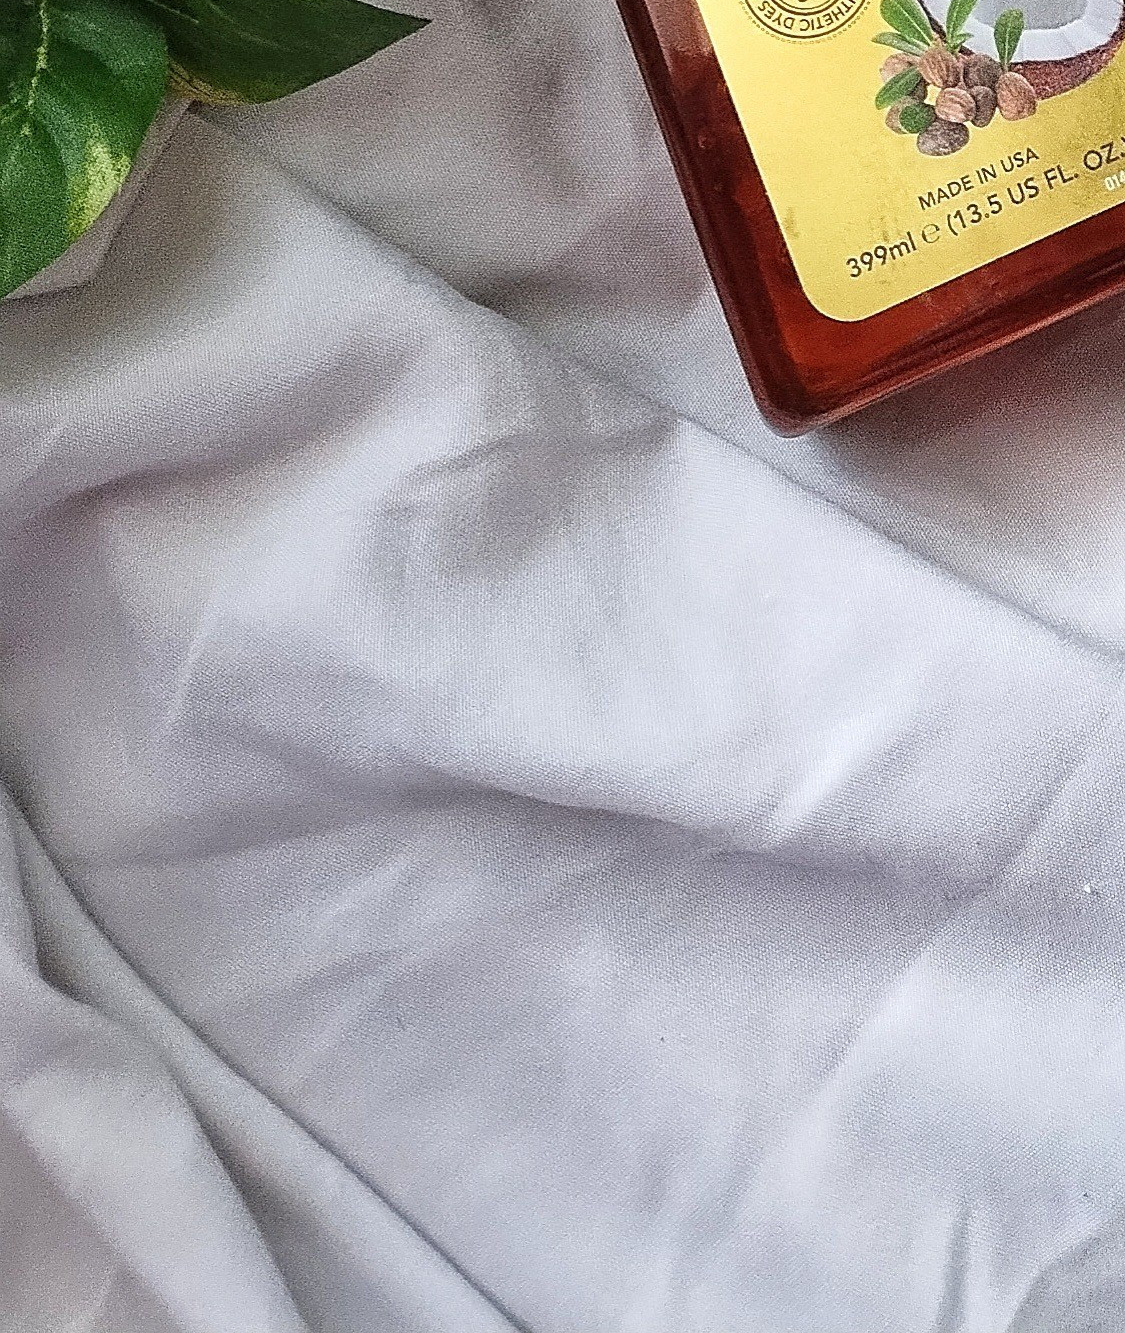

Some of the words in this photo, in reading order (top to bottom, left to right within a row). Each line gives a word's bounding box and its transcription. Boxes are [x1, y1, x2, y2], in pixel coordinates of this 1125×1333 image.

[757, 0, 795, 30] DYES
[918, 176, 974, 210] MADE
[976, 164, 997, 185] IN
[1001, 147, 1039, 173] USA
[846, 231, 916, 278] 399ml
[947, 193, 1002, 236] (13.5
[1007, 176, 1040, 205] US
[1044, 164, 1079, 190] FL.
